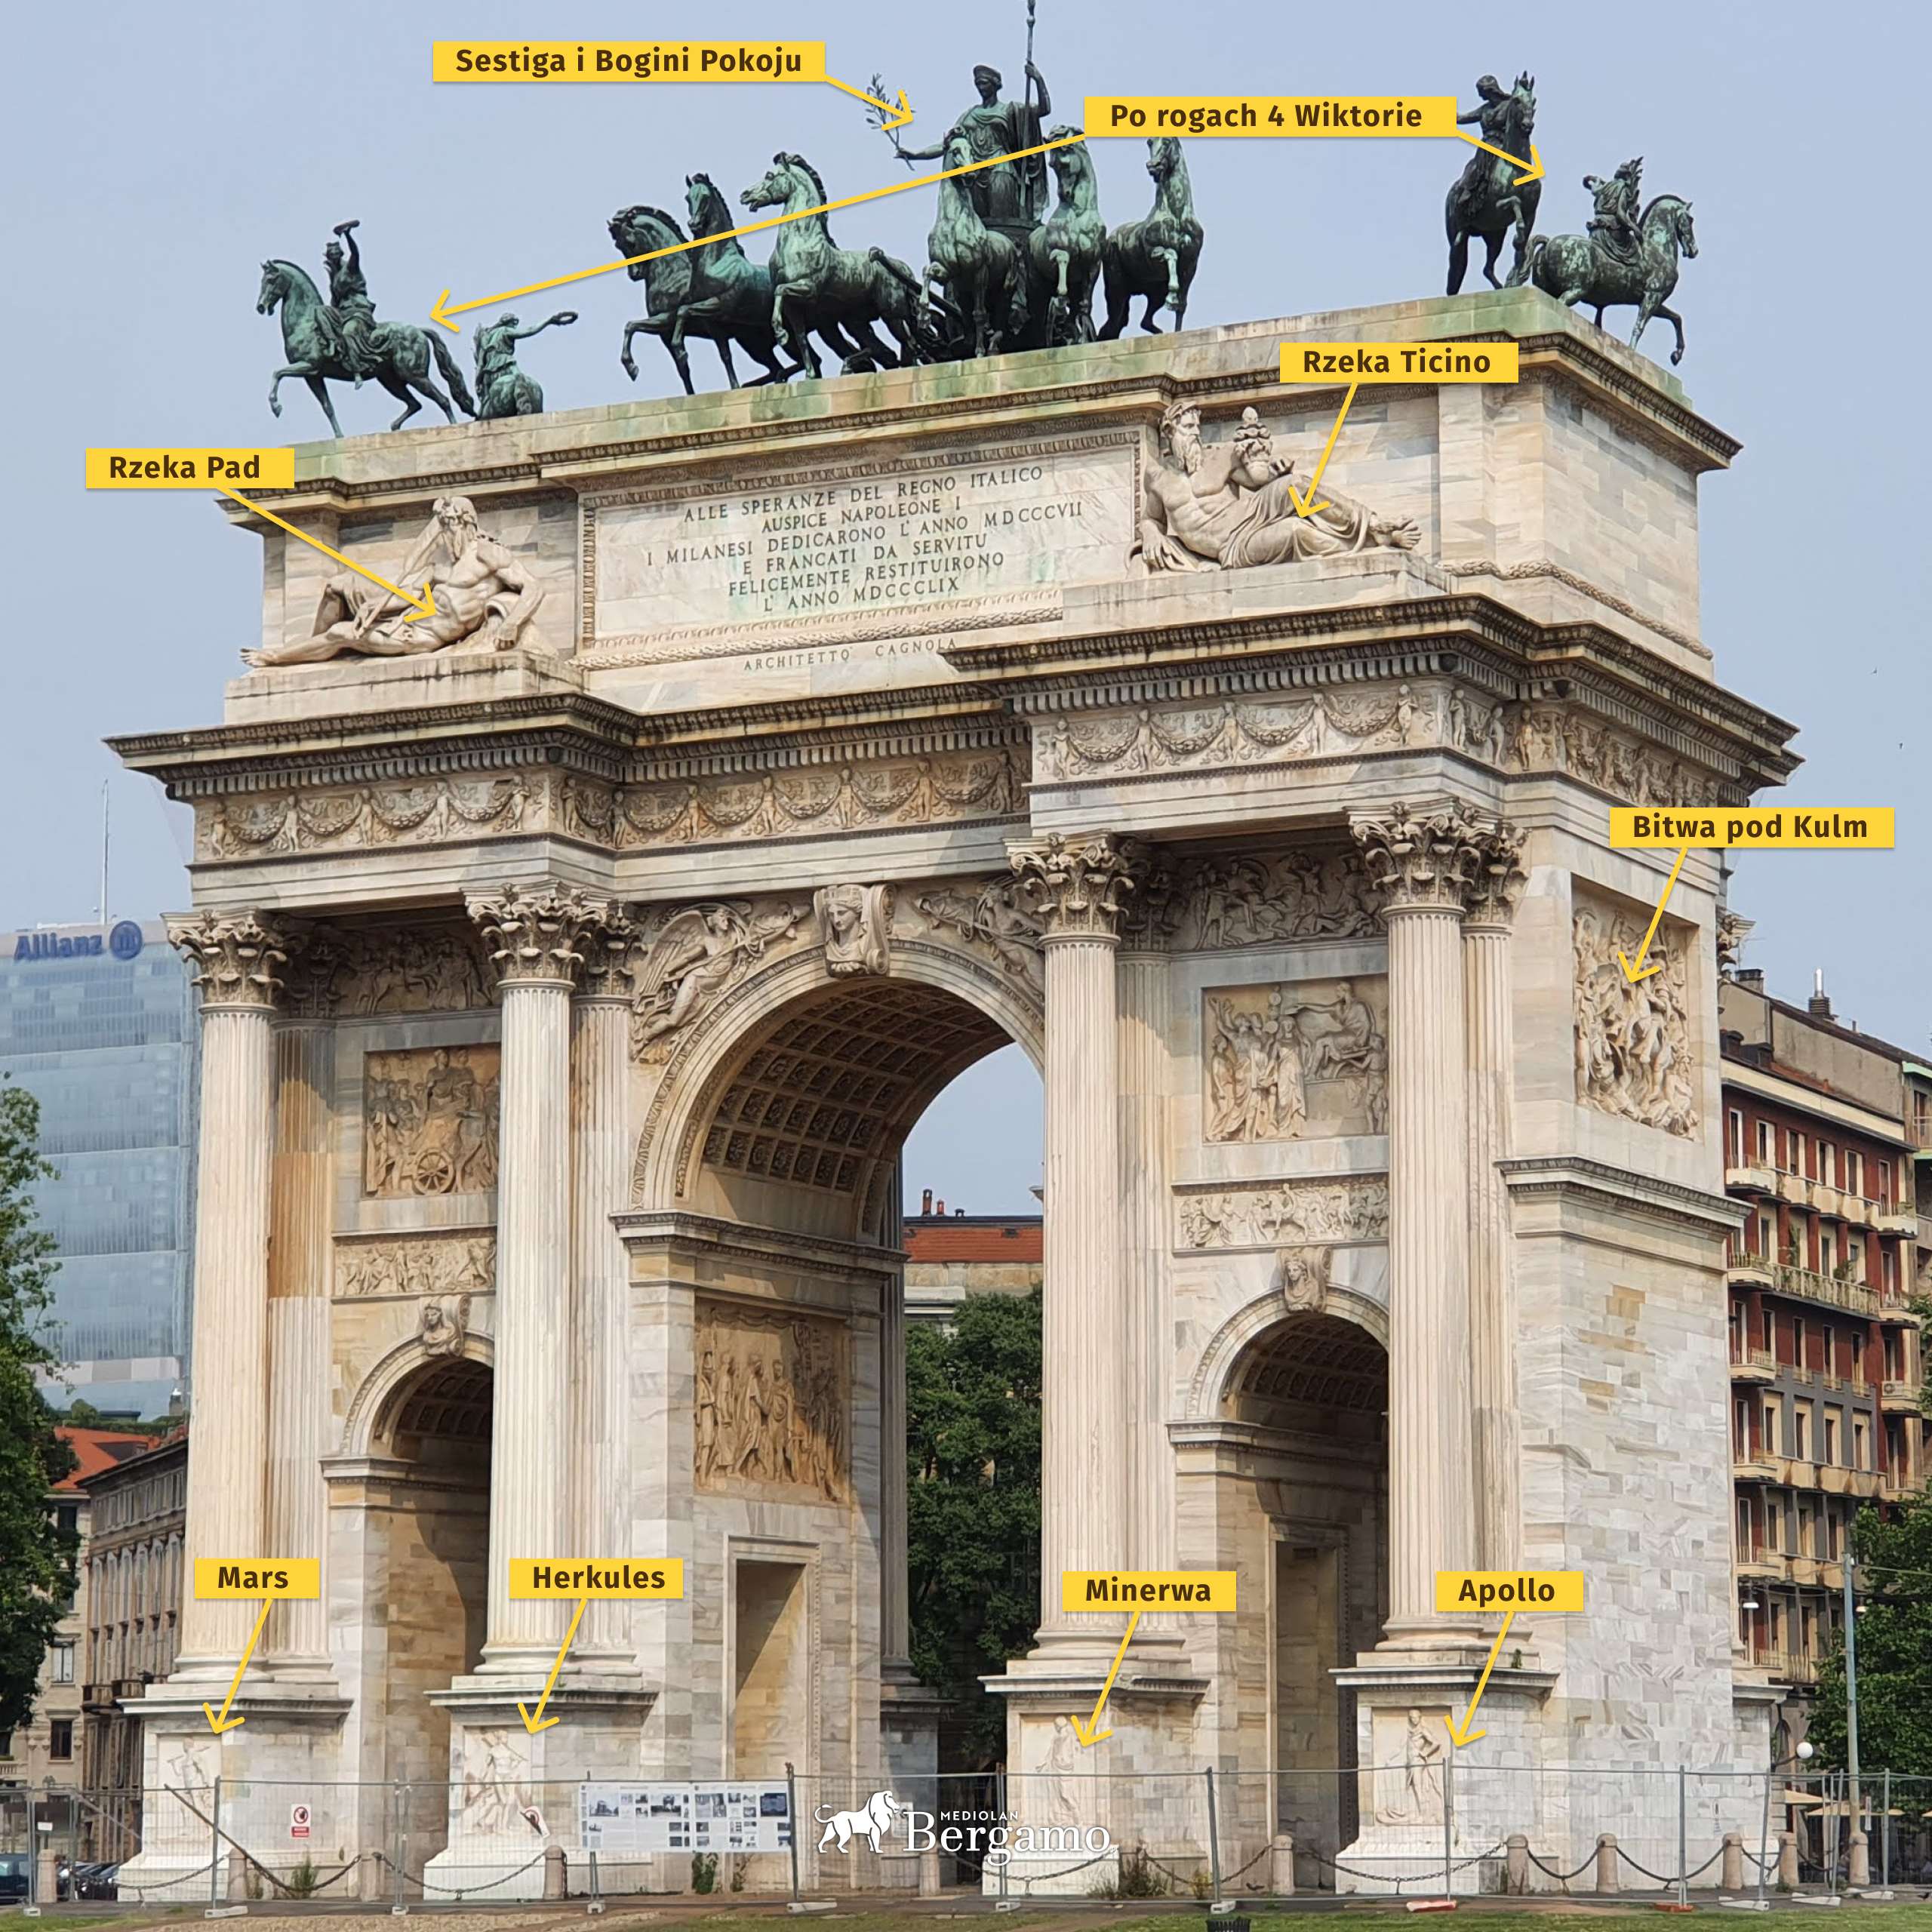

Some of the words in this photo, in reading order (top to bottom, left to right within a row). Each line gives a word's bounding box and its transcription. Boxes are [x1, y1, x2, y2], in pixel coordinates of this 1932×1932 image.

[685, 504, 728, 522] ALLE
[742, 491, 835, 515] SPERANZE
[851, 486, 883, 503] DEL
[898, 476, 956, 497] REGNO
[971, 466, 1042, 488] ITALICO
[761, 512, 826, 533] AUSPICE
[841, 498, 941, 524] NAPOLEONE
[955, 495, 960, 511] I
[648, 552, 652, 566] I
[666, 541, 752, 565] MILANESI
[768, 527, 885, 552] DEDICARONO
[984, 501, 1081, 528] MDCCCVII
[729, 569, 851, 596] FELICEMENTE
[866, 552, 1004, 581] RESTITUIRONO
[743, 561, 751, 575] E
[766, 549, 856, 572] FRANCATI
[874, 545, 897, 560] DA
[913, 533, 987, 555] SERVITU
[854, 577, 959, 603] MDCCCLIX
[744, 648, 851, 671] ARCHITETTO
[875, 638, 957, 657] CAGNOLA
[14, 932, 103, 961] Allianz
